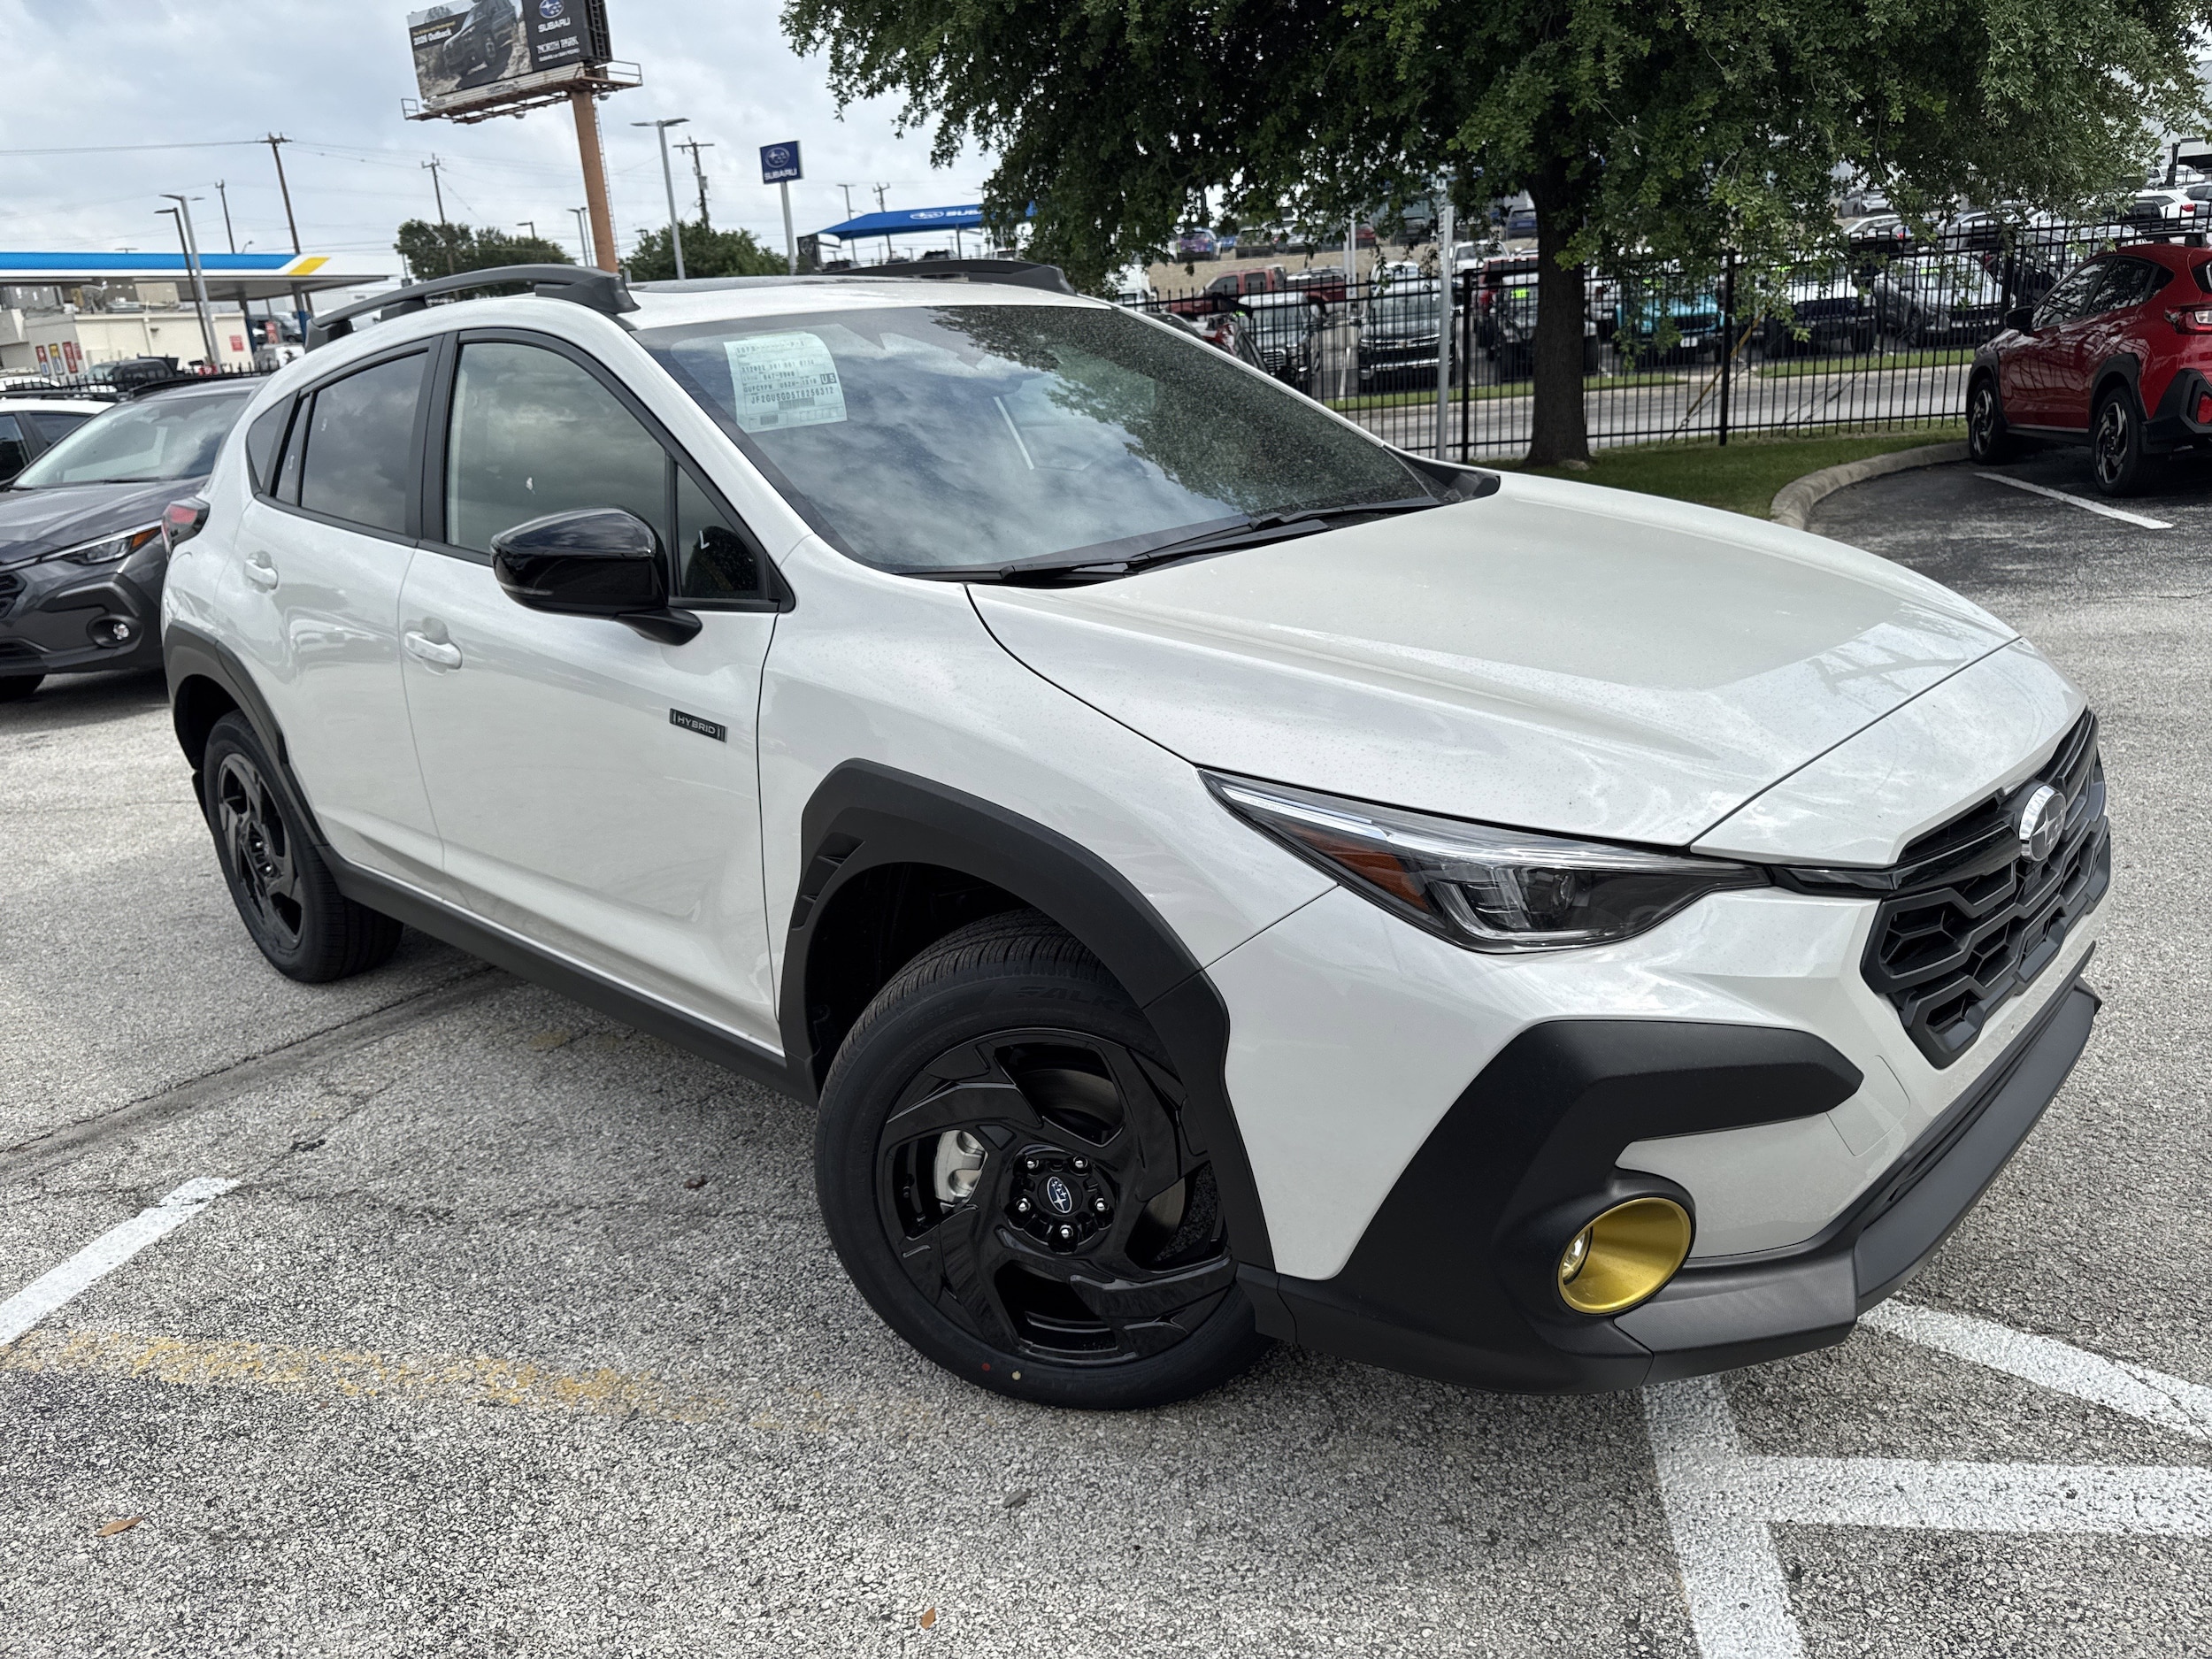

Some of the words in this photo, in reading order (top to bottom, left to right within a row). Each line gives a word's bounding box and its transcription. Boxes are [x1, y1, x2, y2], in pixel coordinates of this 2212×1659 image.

[537, 17, 571, 33] SUBARU
[764, 168, 797, 180] SUBARU
[751, 386, 834, 404] JF2GUSGD5T8256312
[678, 715, 716, 734] HYBRID
[1014, 986, 1145, 1021] FALKE
[904, 1002, 956, 1034] OUTSIDE
